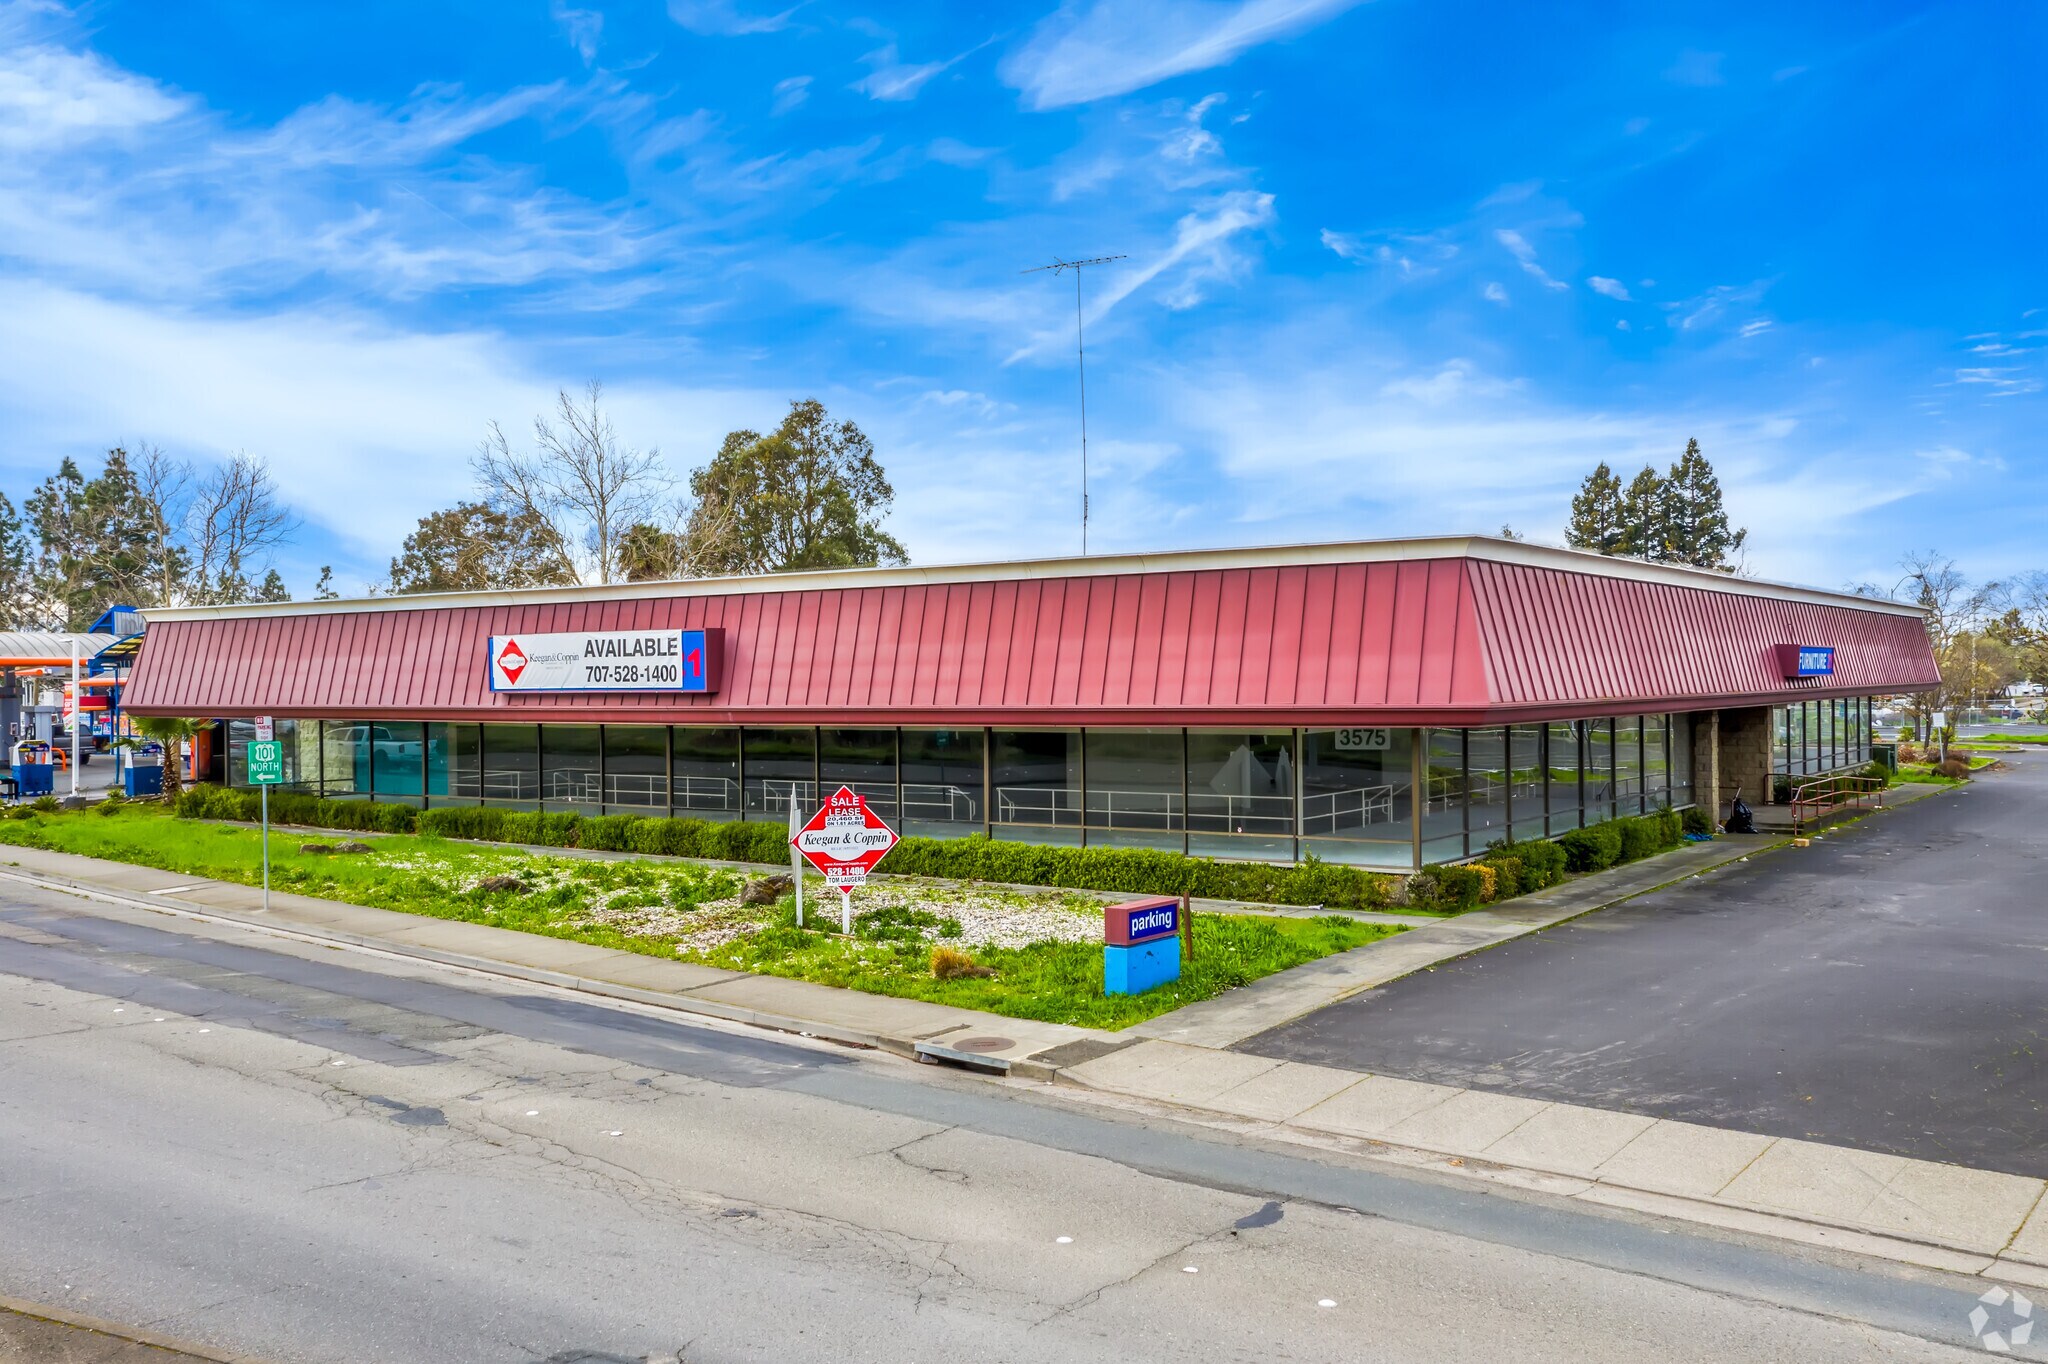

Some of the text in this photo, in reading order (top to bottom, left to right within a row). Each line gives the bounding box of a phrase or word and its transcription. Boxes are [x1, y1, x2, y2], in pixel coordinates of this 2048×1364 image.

[584, 637, 678, 657] AVAILABLE
[1798, 652, 1827, 670] FURNITURE
[585, 664, 677, 683] 707-528-1400
[1340, 729, 1386, 746] 3575
[258, 747, 273, 759] 101
[250, 762, 279, 772] NORTH
[831, 797, 860, 806] SALE
[828, 807, 861, 816] LEASE
[804, 831, 888, 847] Keegan & Coppin
[827, 866, 865, 876] 528-1400
[1131, 910, 1172, 936] parking
